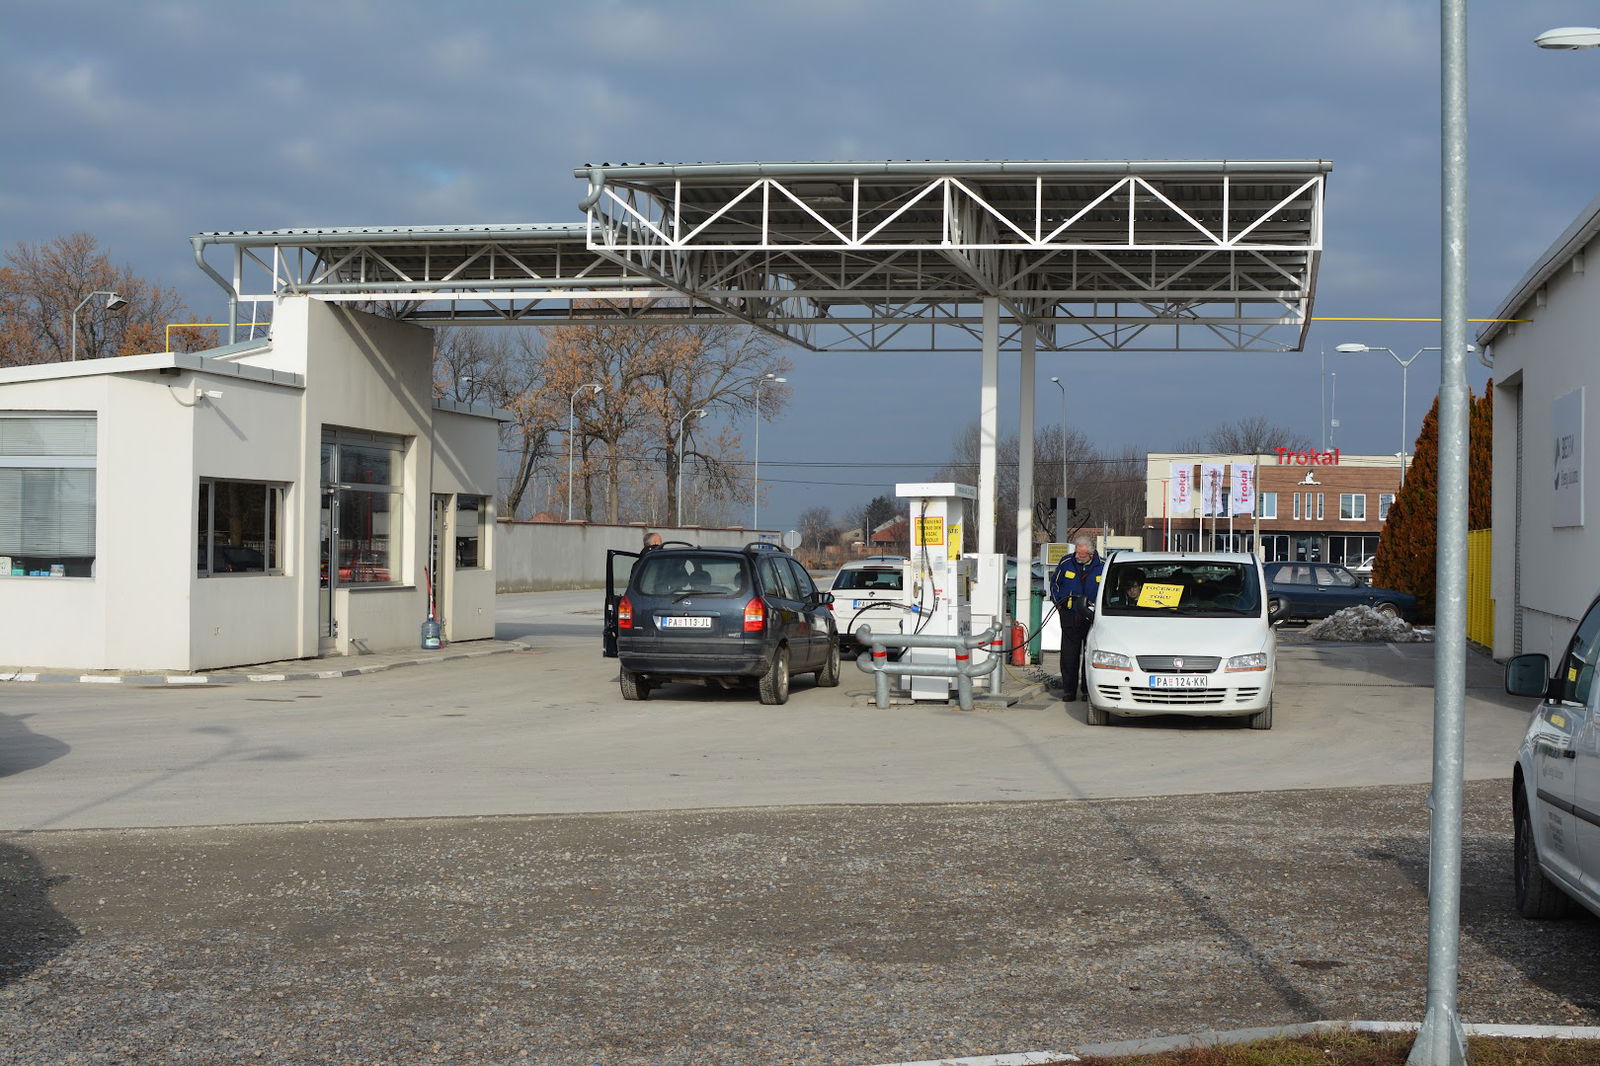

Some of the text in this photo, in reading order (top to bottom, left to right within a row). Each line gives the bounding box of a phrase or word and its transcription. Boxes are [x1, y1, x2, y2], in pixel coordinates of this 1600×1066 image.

[1274, 447, 1340, 465] Trokal
[1178, 470, 1186, 503] Trokal
[1240, 470, 1249, 503] Trokal
[668, 618, 678, 627] PA
[1156, 677, 1168, 687] PA
